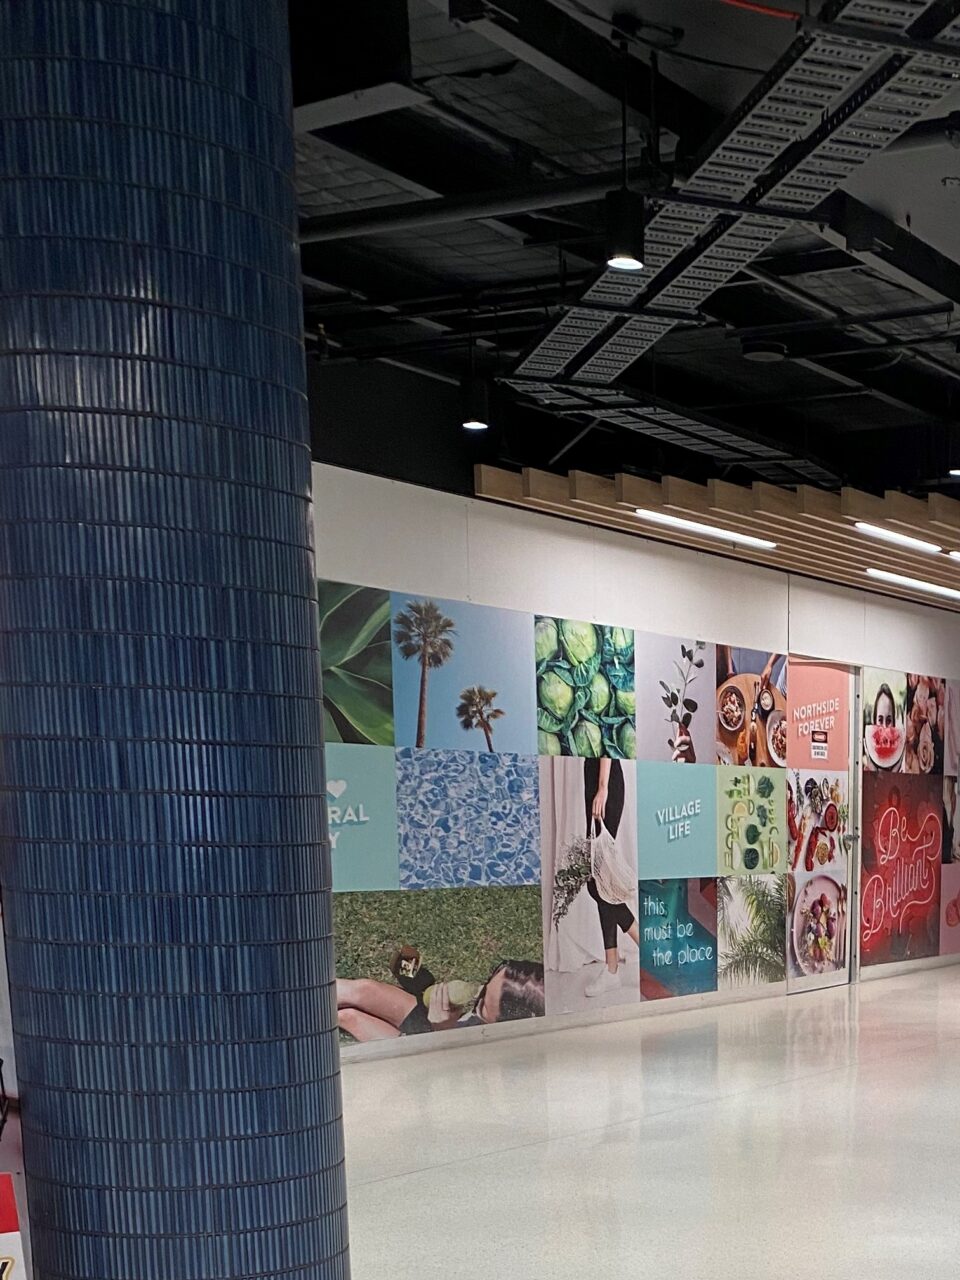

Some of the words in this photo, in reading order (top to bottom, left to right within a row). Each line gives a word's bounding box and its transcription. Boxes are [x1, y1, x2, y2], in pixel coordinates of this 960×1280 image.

[793, 698, 839, 721] NORTHSIDE
[798, 716, 835, 737] FOREVER
[657, 799, 701, 824] VILLAGE
[668, 820, 691, 840] LIFE
[861, 836, 935, 942] Brilliant
[644, 923, 672, 942] must
[676, 919, 695, 938] be
[652, 949, 673, 967] the
[677, 945, 714, 968] place
